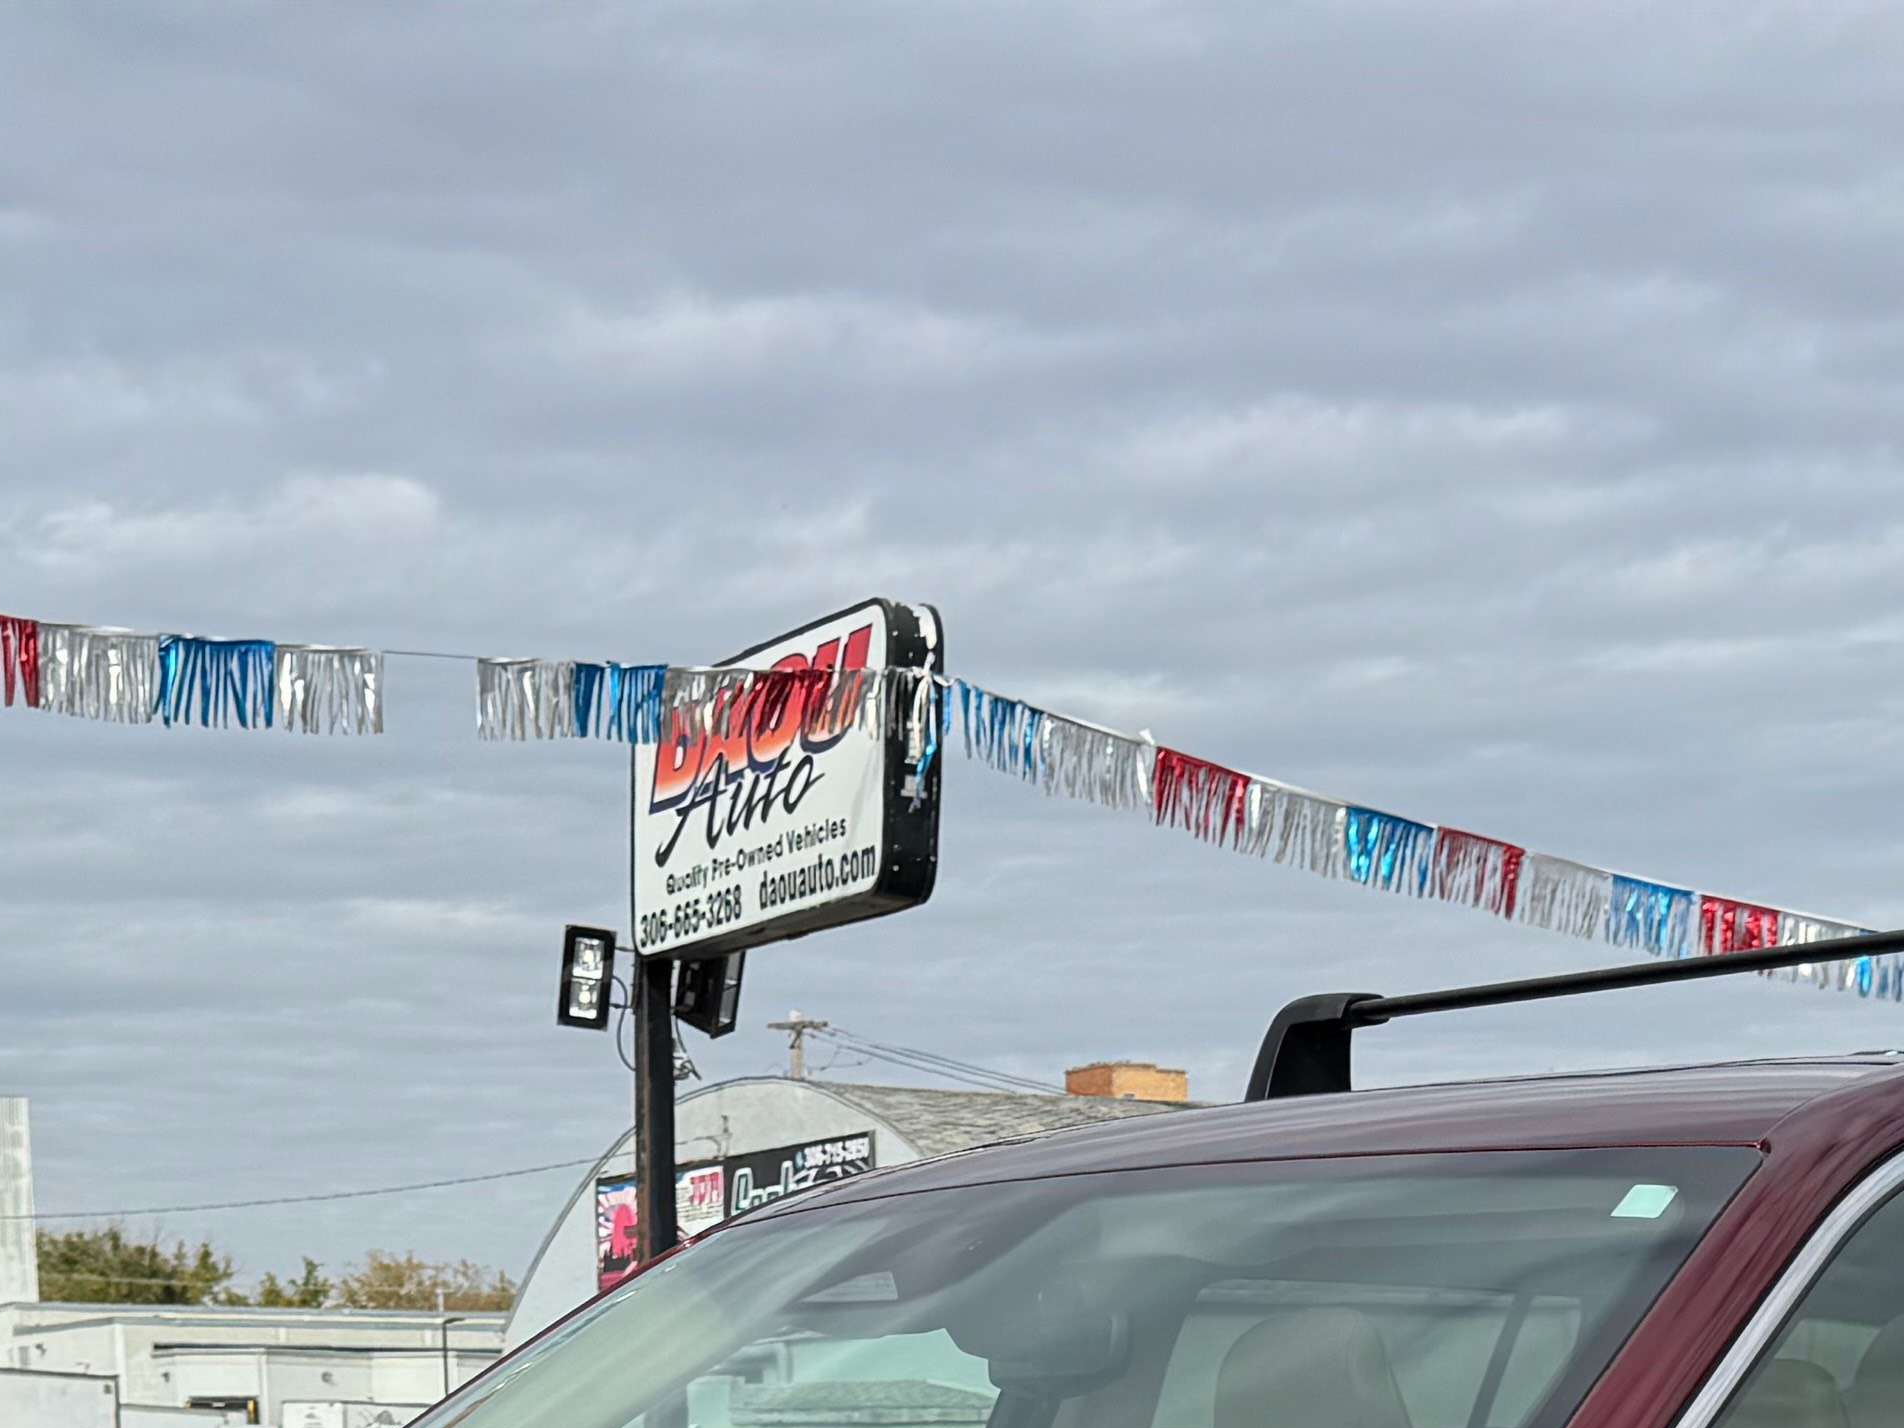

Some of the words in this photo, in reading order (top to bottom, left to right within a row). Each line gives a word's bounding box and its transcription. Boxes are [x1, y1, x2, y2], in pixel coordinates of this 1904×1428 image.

[655, 746, 825, 868] Auto
[666, 865, 709, 895] Quality
[712, 834, 783, 882] Pre-Owned
[786, 818, 847, 854] Vehicles
[640, 884, 742, 949] 306-665-3268
[759, 845, 876, 911] daouauto.com
